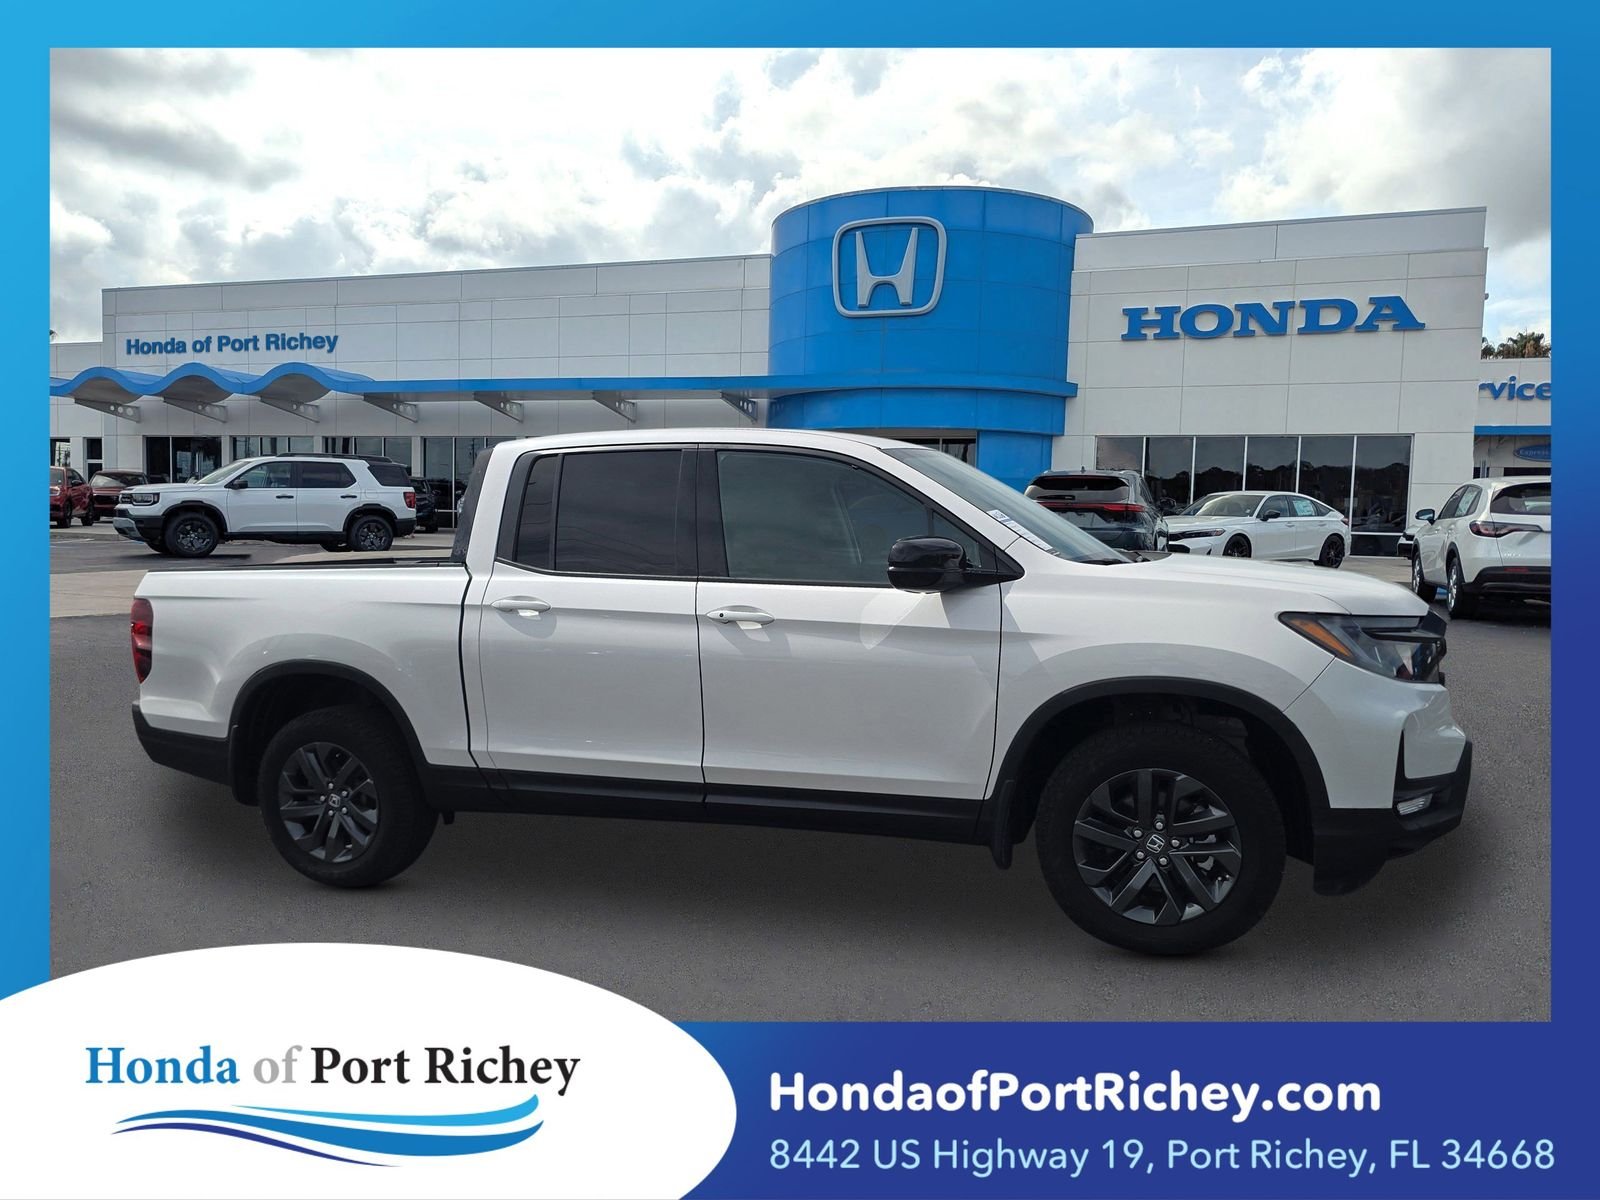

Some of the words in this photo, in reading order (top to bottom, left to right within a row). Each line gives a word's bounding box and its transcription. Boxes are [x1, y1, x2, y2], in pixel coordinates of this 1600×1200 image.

[1121, 295, 1426, 341] HONDA
[126, 337, 187, 356] Honda
[191, 335, 212, 354] of
[217, 335, 260, 353] Port
[265, 332, 339, 354] Richey
